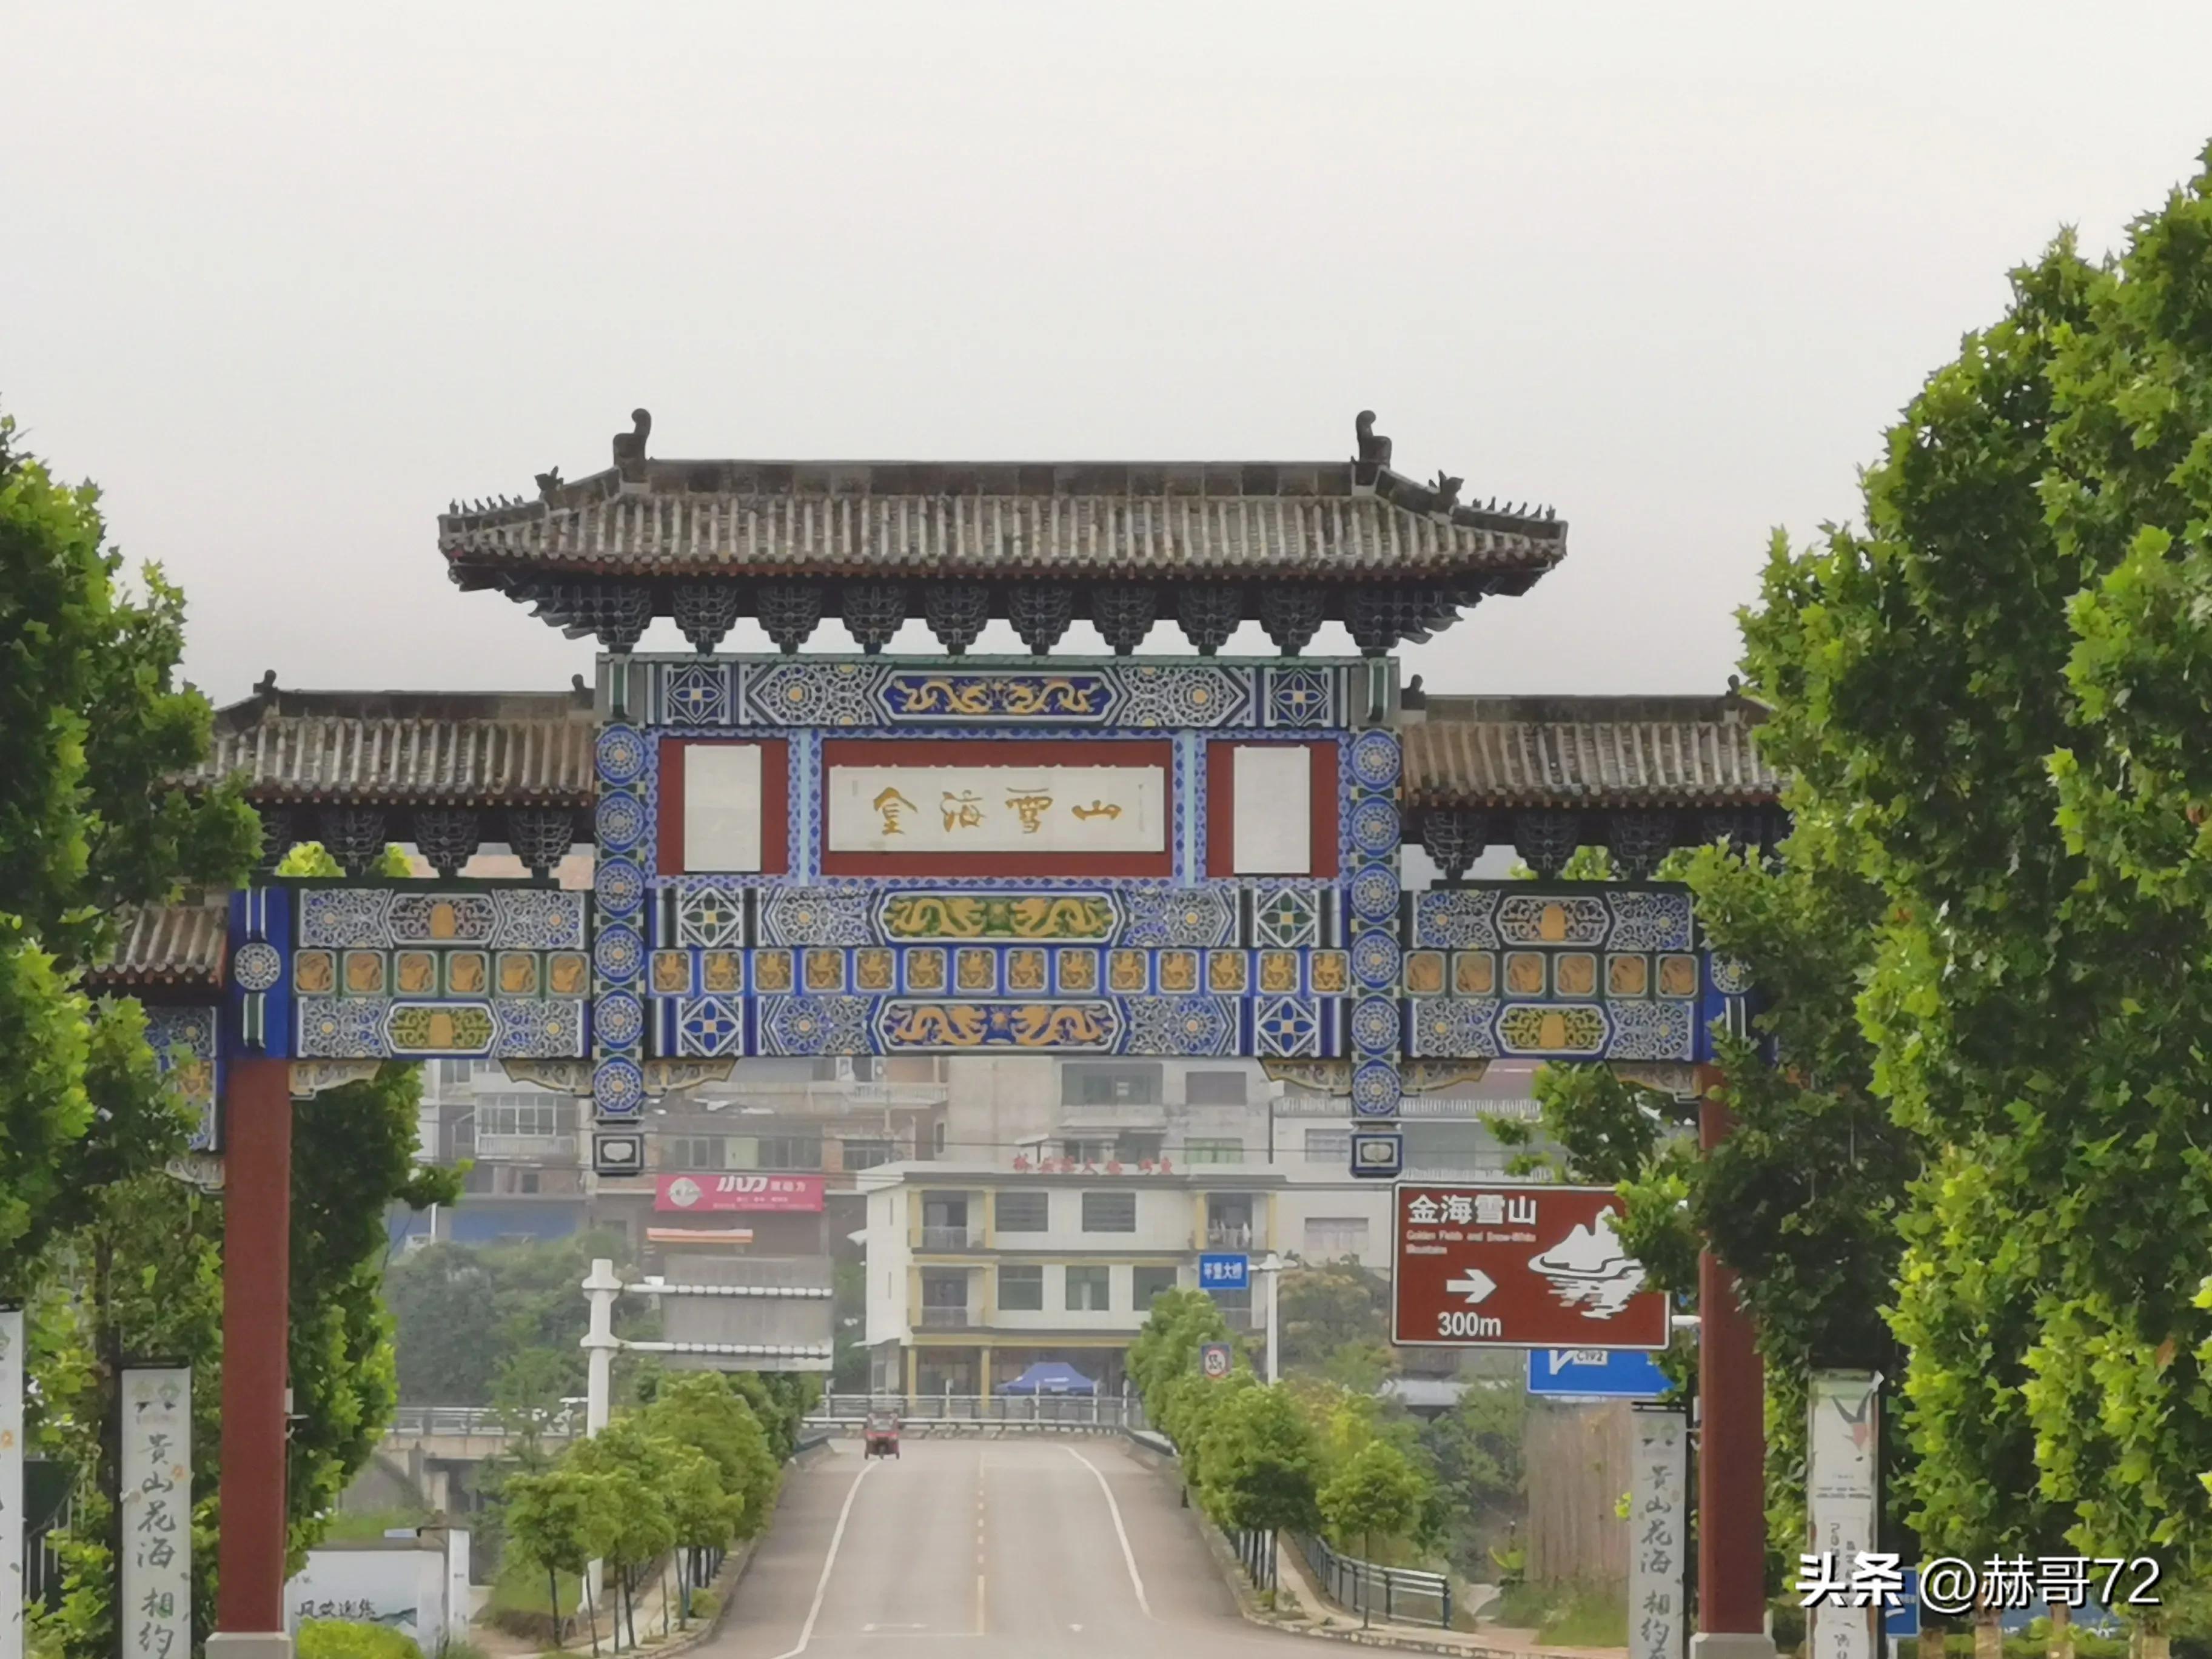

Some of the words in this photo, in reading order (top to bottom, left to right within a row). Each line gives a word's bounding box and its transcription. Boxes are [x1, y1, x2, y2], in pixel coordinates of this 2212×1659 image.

[1407, 1194, 1537, 1225] 金海雪山
[1437, 1312, 1501, 1337] 300m
